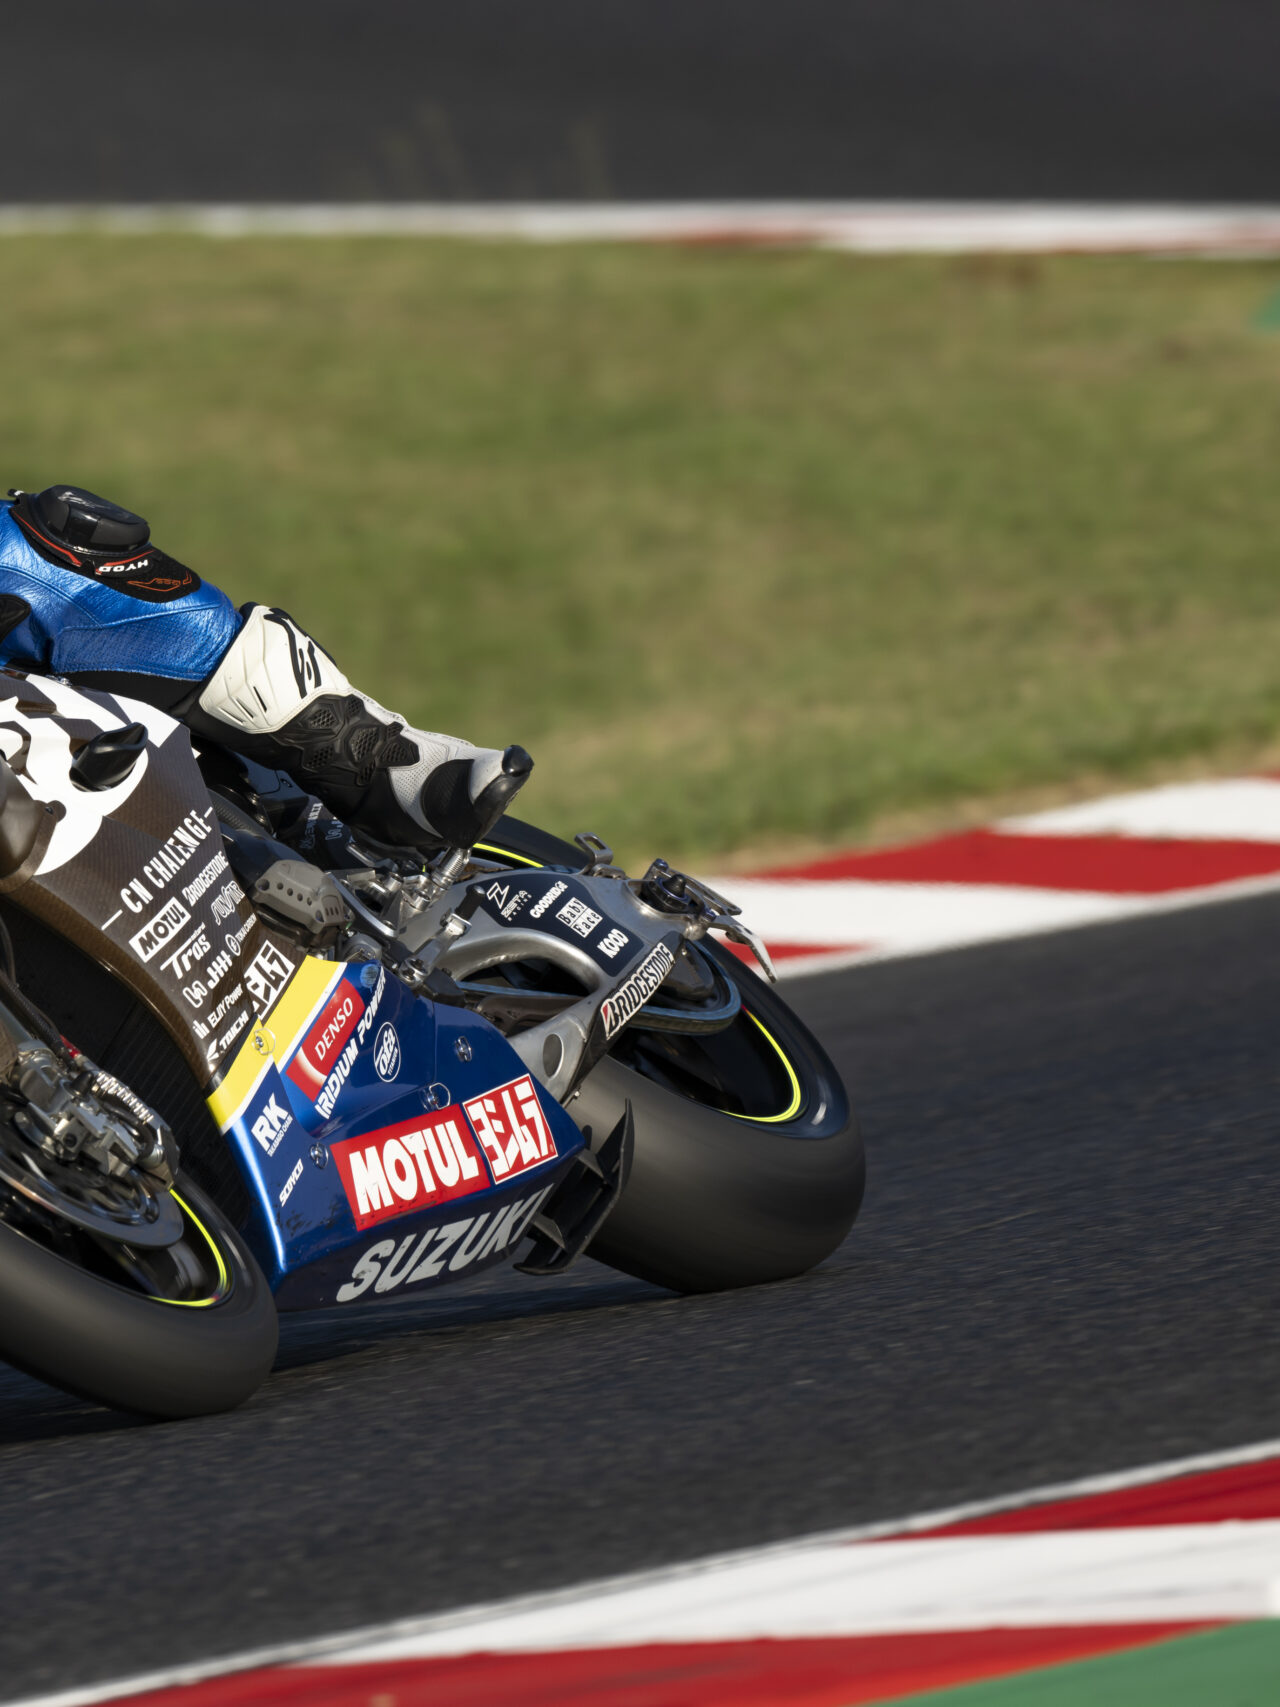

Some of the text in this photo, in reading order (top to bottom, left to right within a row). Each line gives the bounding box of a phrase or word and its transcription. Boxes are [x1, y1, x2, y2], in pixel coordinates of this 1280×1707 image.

[99, 560, 149, 572] HYOD
[120, 878, 153, 913] CN
[182, 850, 230, 907] BRIDGESTONE
[138, 902, 186, 956] MOTUL
[500, 890, 528, 918] ZETA
[557, 899, 588, 925] Baby
[573, 911, 602, 936] Face
[597, 928, 629, 959] KOOD
[223, 983, 244, 1010] Power
[601, 942, 675, 1040] BRIDGESTONE
[314, 997, 353, 1061] DENSO
[314, 1038, 359, 1120] IRIDIUM
[358, 966, 386, 1046] POWER
[251, 1092, 289, 1152] RK
[282, 1114, 293, 1133] CHAIN
[279, 1158, 304, 1208] SCOYCO
[349, 1120, 480, 1216] MOTUL
[336, 1183, 555, 1302] SUZUKI
